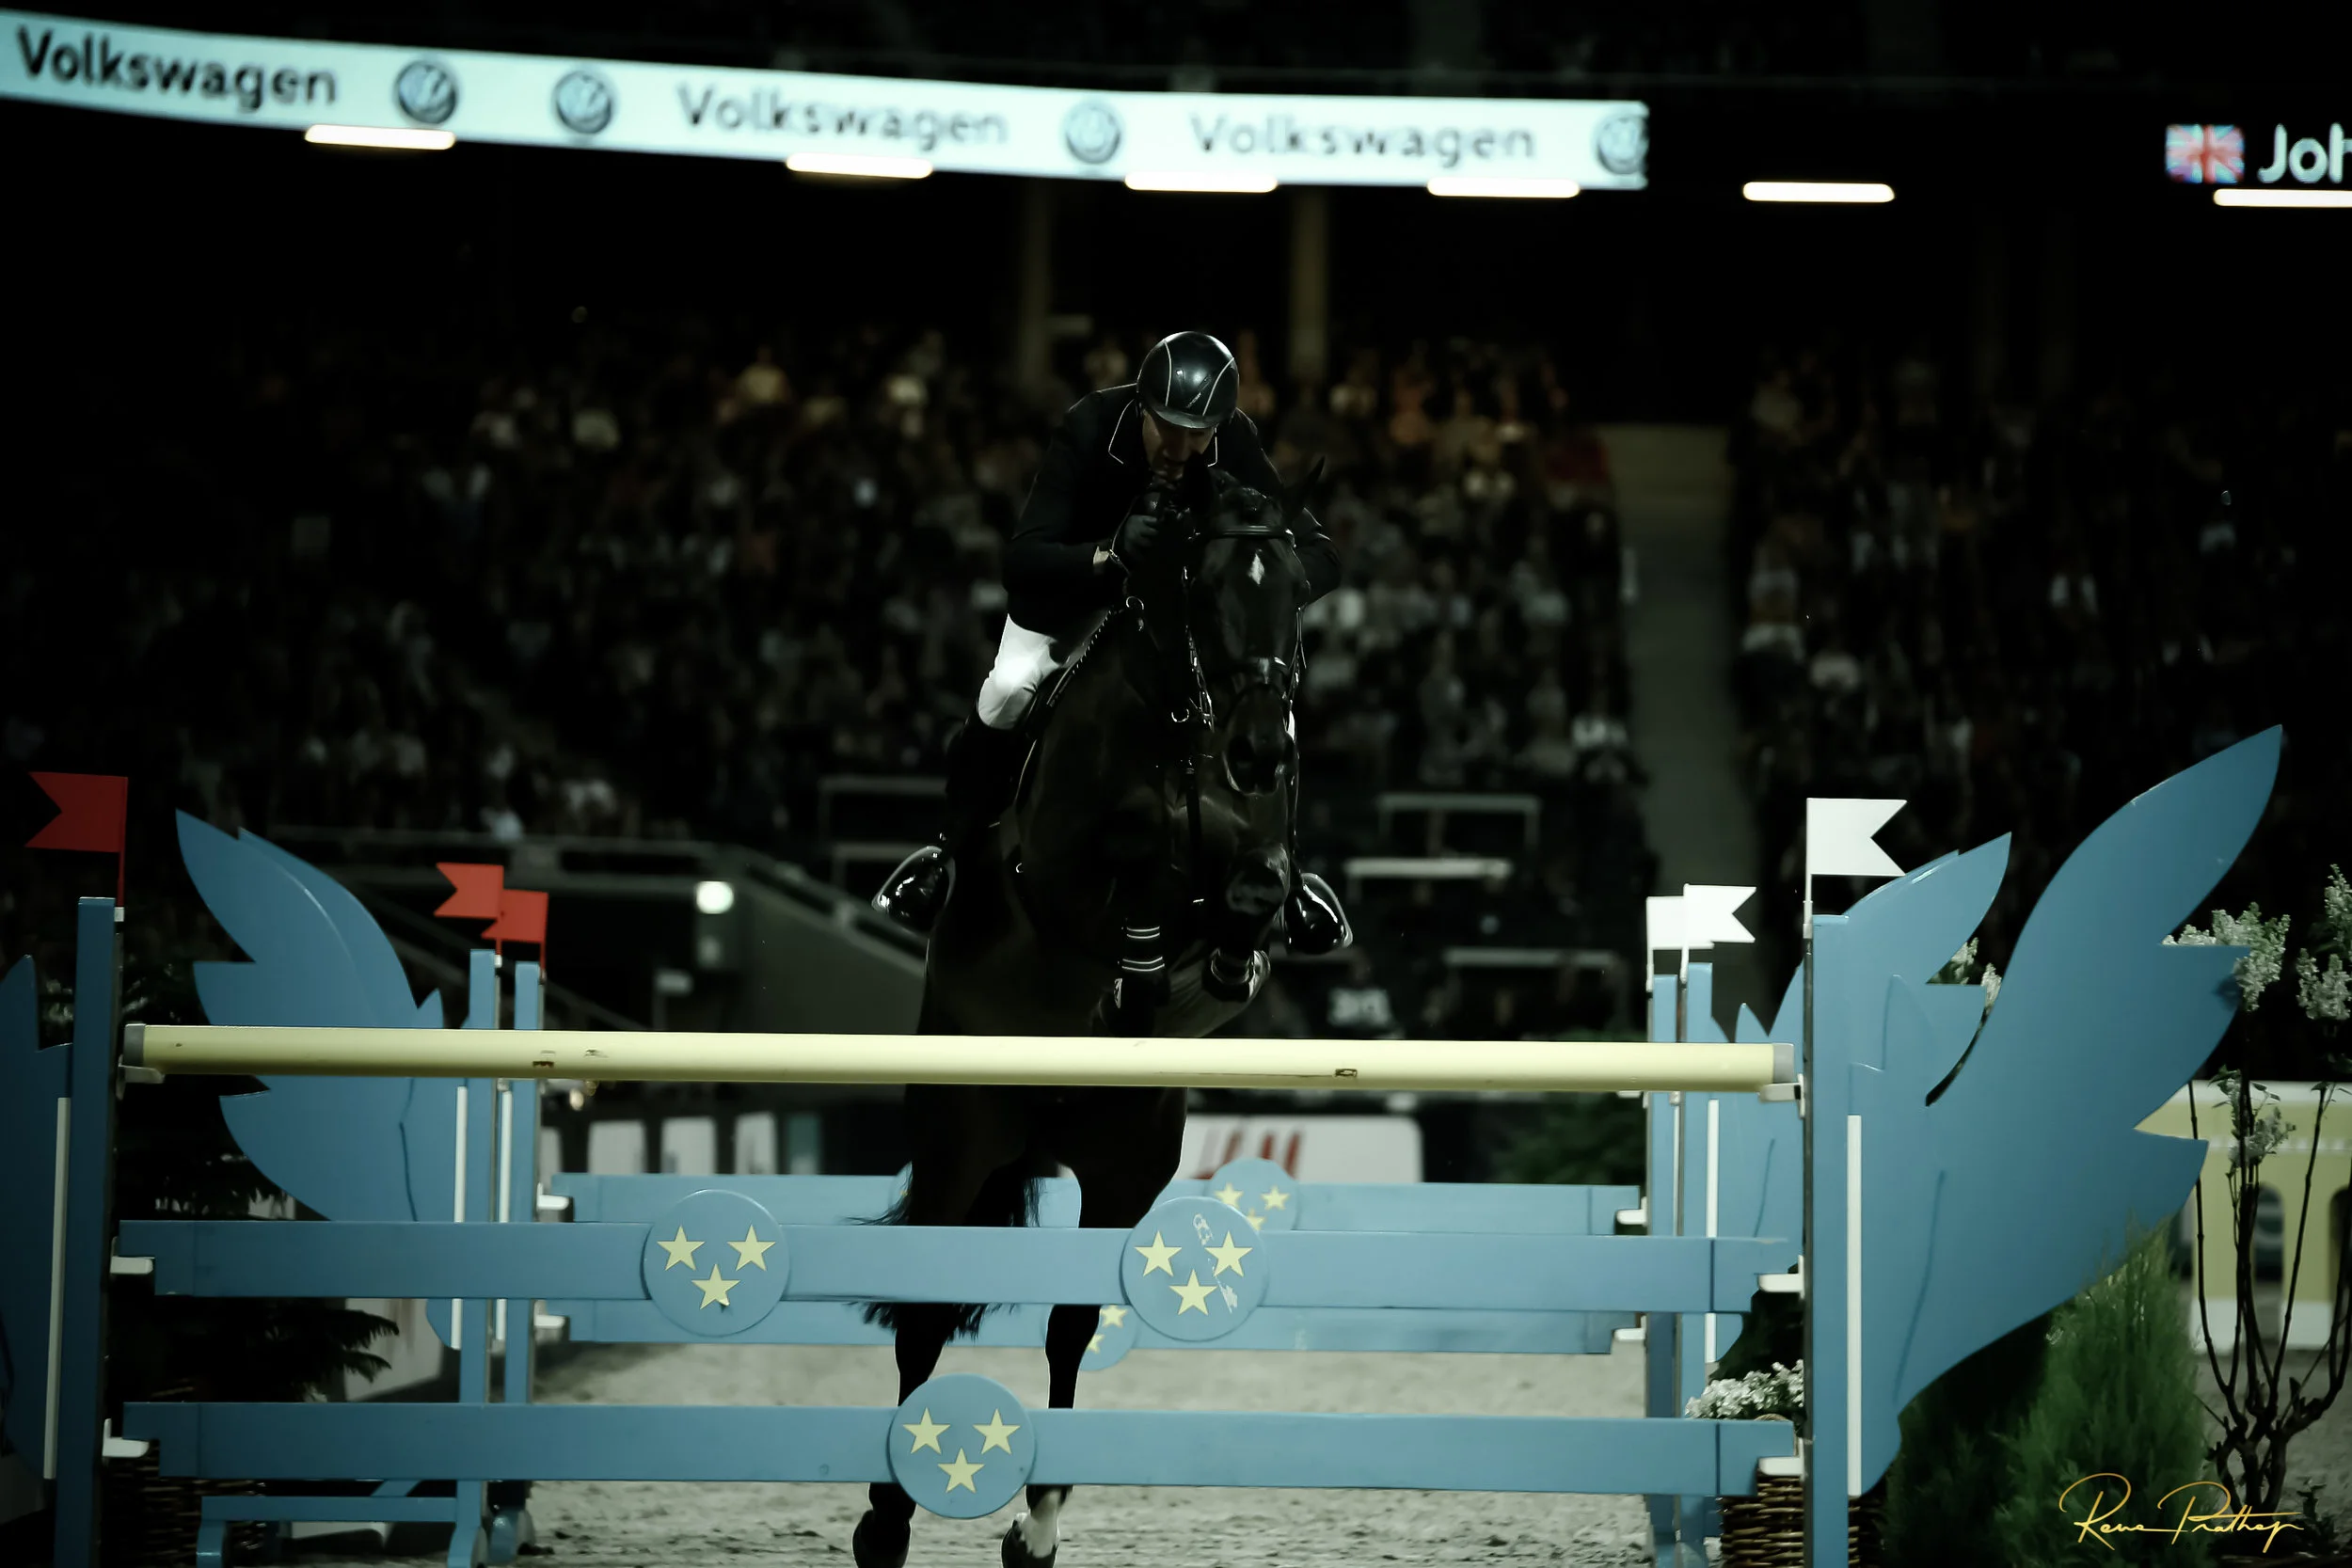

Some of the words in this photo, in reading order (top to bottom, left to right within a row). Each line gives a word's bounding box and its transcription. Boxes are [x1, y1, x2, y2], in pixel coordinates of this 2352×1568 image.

[16, 25, 337, 111] Volkswagen
[675, 83, 1009, 151] Volkswagen
[1191, 113, 1534, 168] Volkswagen
